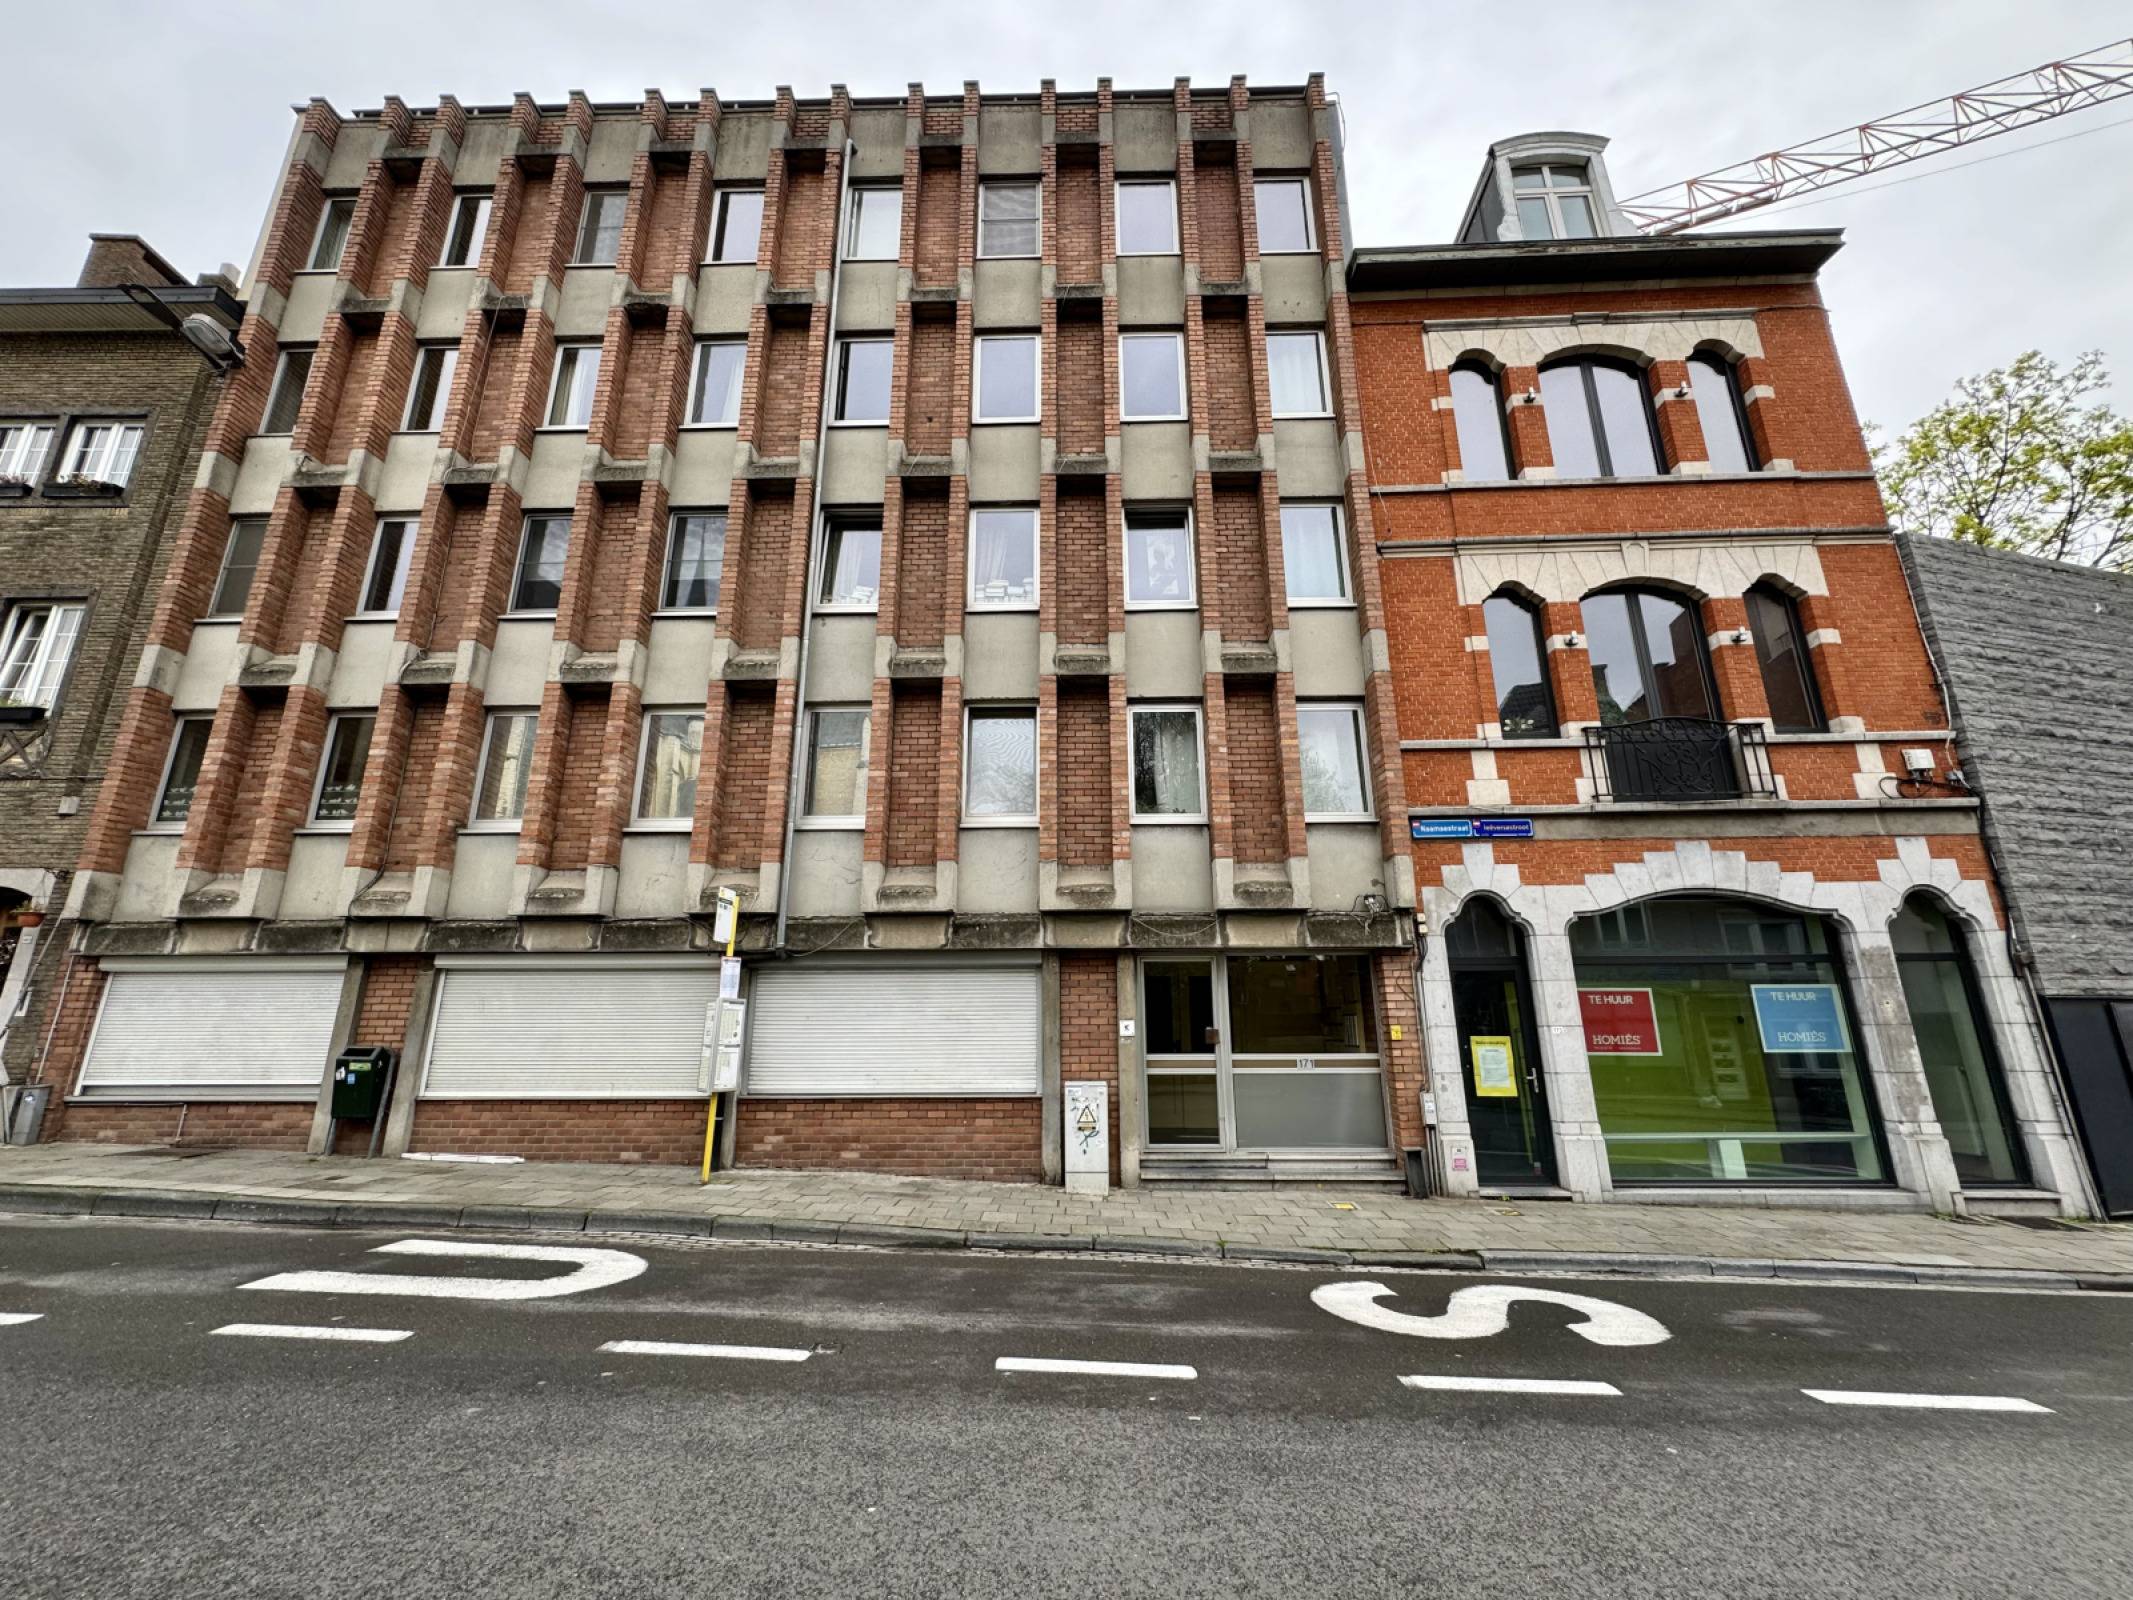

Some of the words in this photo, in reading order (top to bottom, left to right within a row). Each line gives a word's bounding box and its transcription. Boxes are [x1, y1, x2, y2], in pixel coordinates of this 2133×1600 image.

[1420, 824, 1469, 833] Naamsestraat
[1587, 995, 1602, 1005] TE
[1603, 995, 1634, 1005] HUUR
[1770, 991, 1785, 1001] TE
[1786, 991, 1816, 1001] HUUR
[1299, 1058, 1314, 1069] 171
